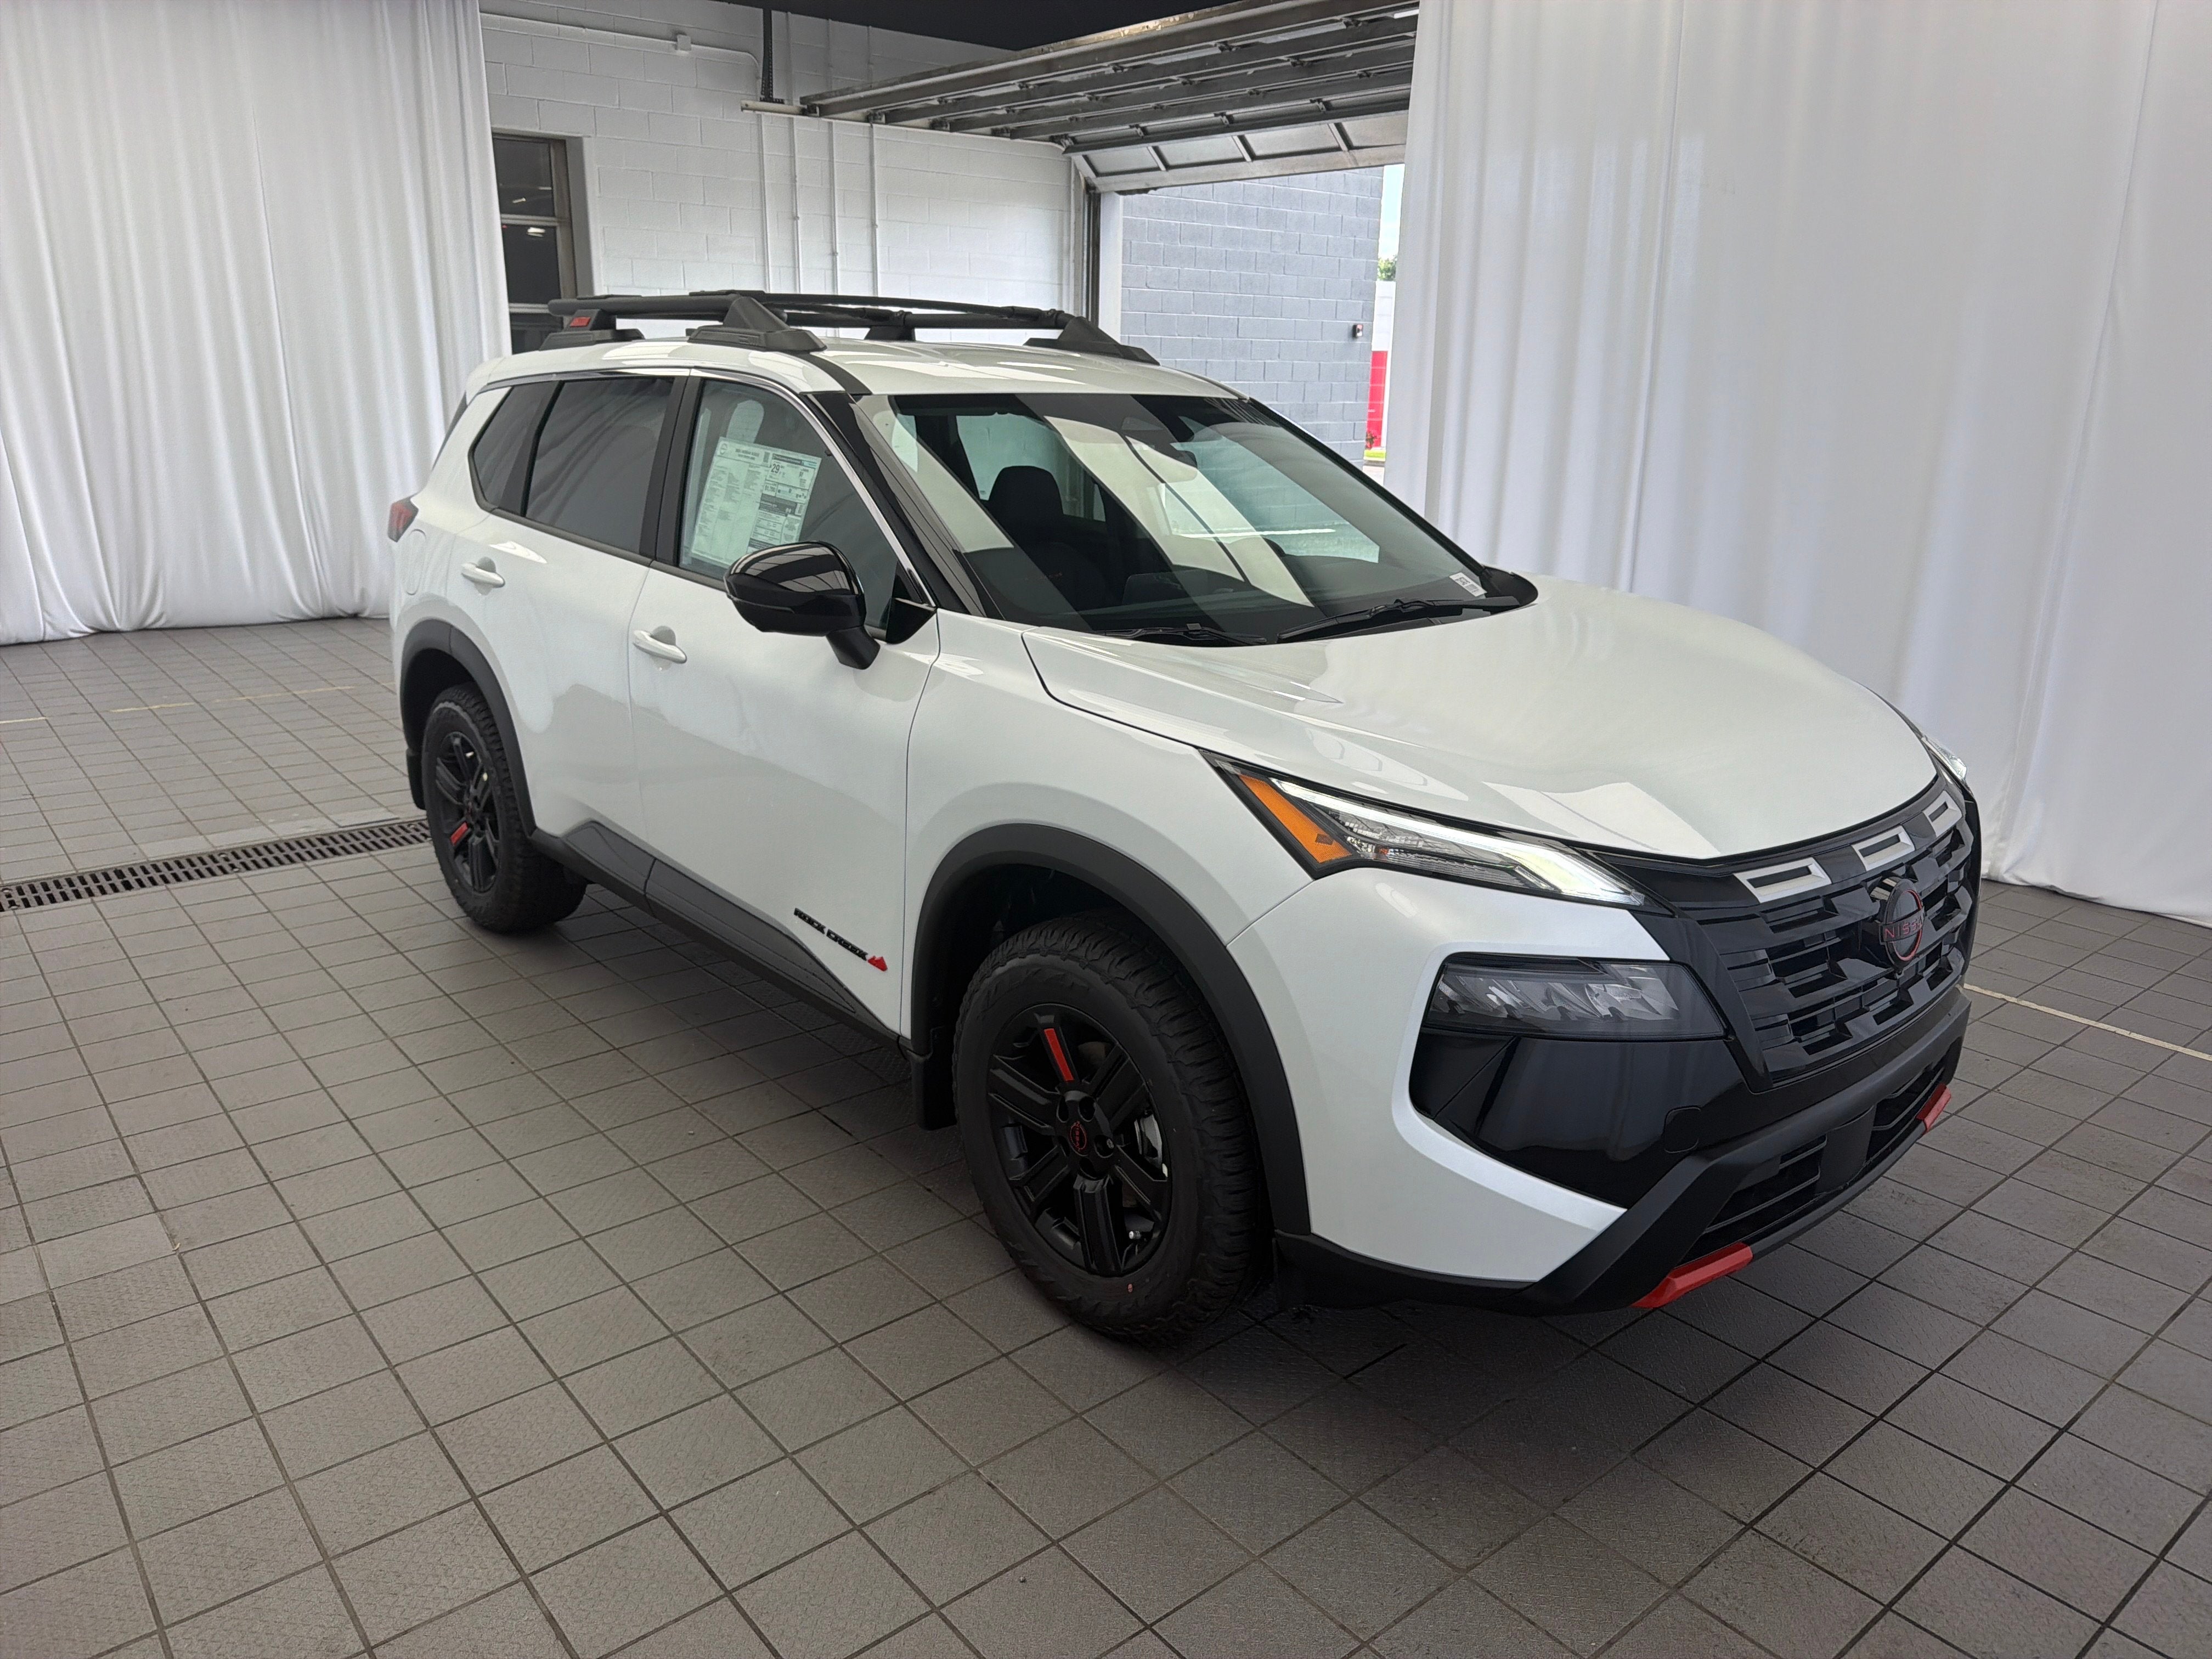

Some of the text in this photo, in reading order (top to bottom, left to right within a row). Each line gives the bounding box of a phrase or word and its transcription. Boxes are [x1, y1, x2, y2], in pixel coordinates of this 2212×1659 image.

[771, 464, 780, 473] 29
[794, 908, 869, 961] ROCK CREEK
[1884, 915, 1923, 940] NISSA
